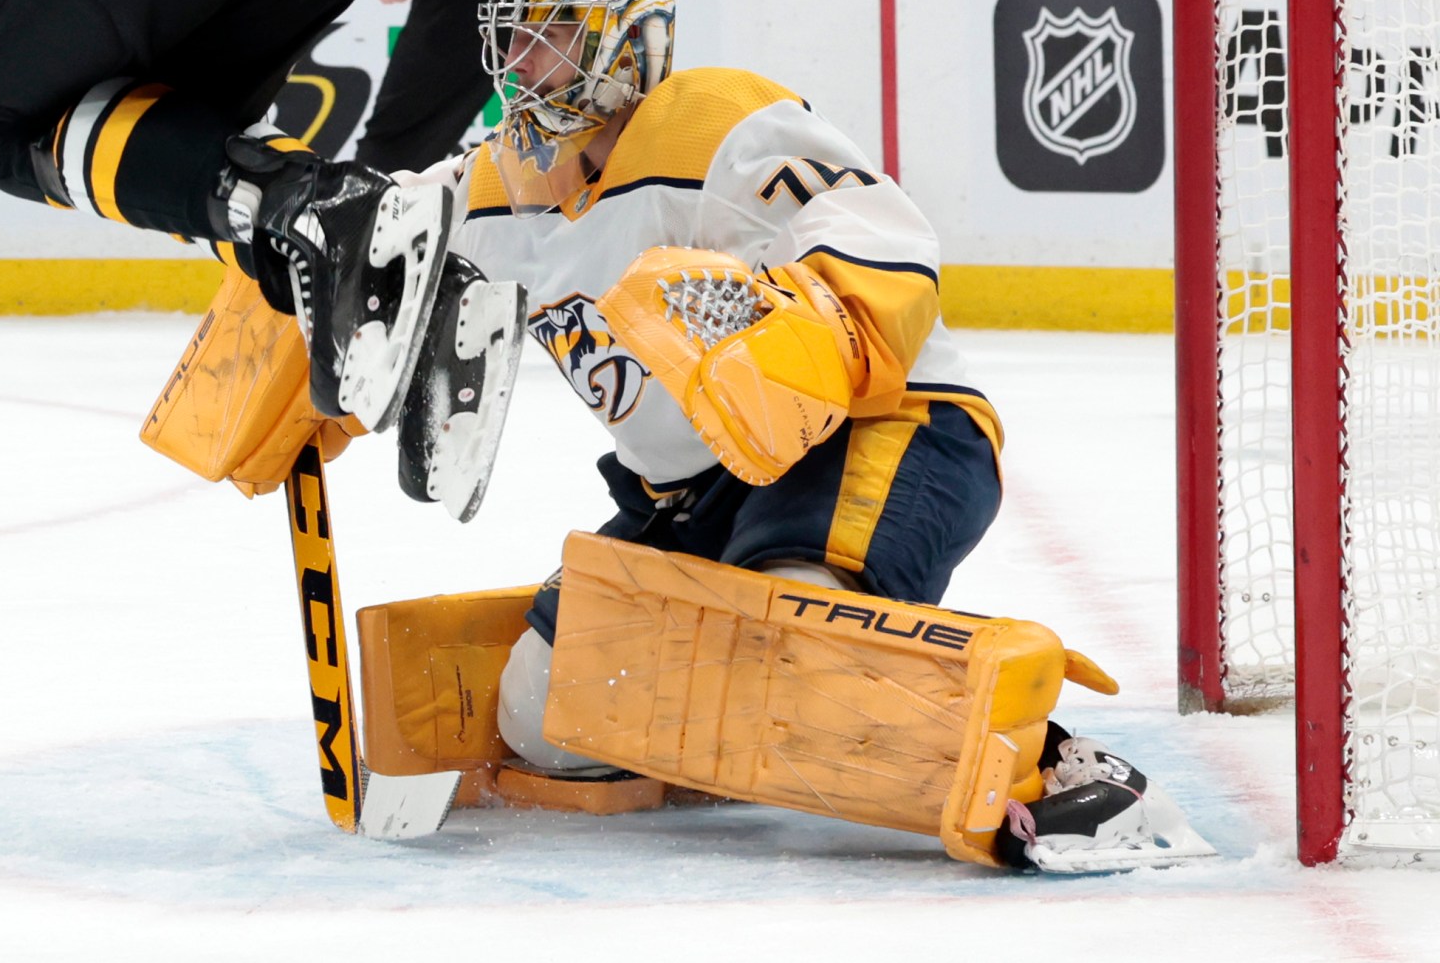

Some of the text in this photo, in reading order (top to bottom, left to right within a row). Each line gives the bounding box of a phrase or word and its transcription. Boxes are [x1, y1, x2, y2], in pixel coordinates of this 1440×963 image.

[1049, 48, 1113, 128] NHL
[807, 275, 860, 360] TRUE
[144, 308, 216, 433] TRUE
[291, 445, 348, 802] CCM
[776, 593, 974, 651] TRUE
